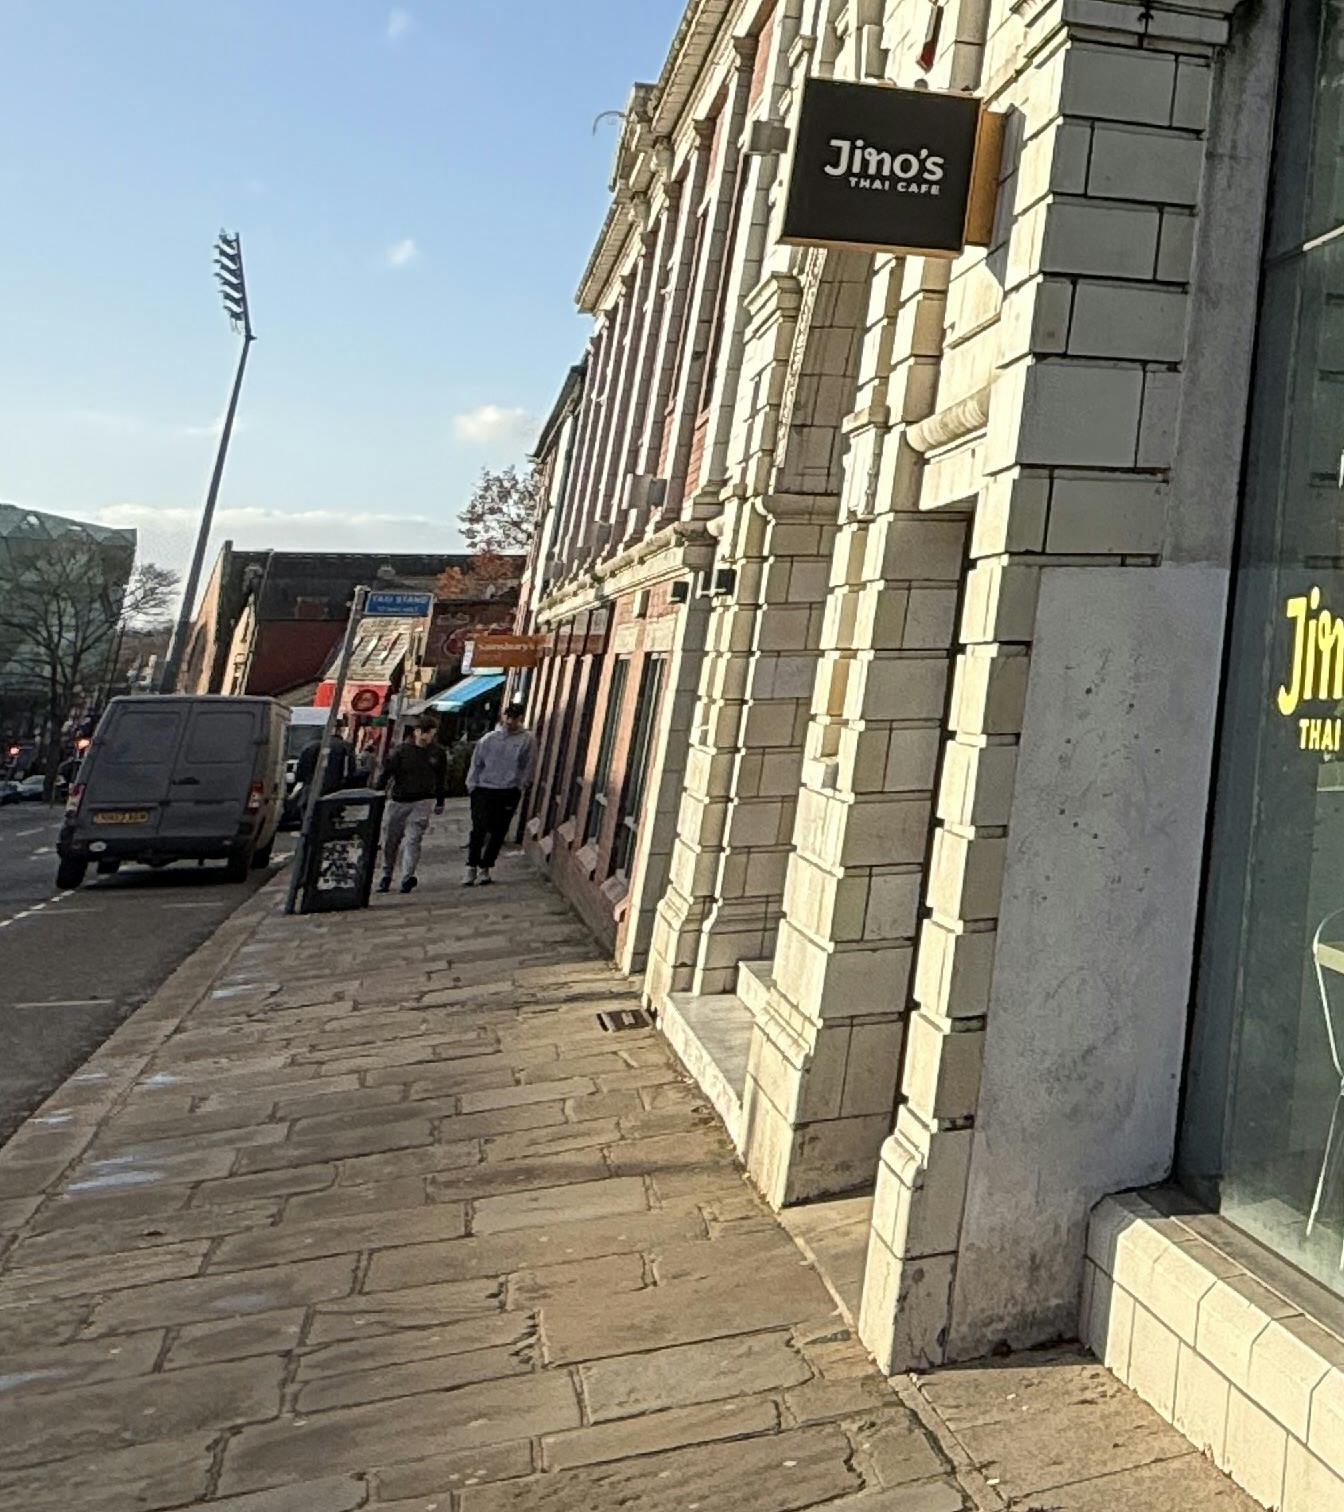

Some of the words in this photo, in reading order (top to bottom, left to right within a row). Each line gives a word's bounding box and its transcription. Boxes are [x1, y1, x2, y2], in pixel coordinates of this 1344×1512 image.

[824, 139, 944, 180] Jino's
[849, 176, 889, 190] THAI
[897, 182, 940, 195] CAFE
[1299, 718, 1342, 751] THAI
